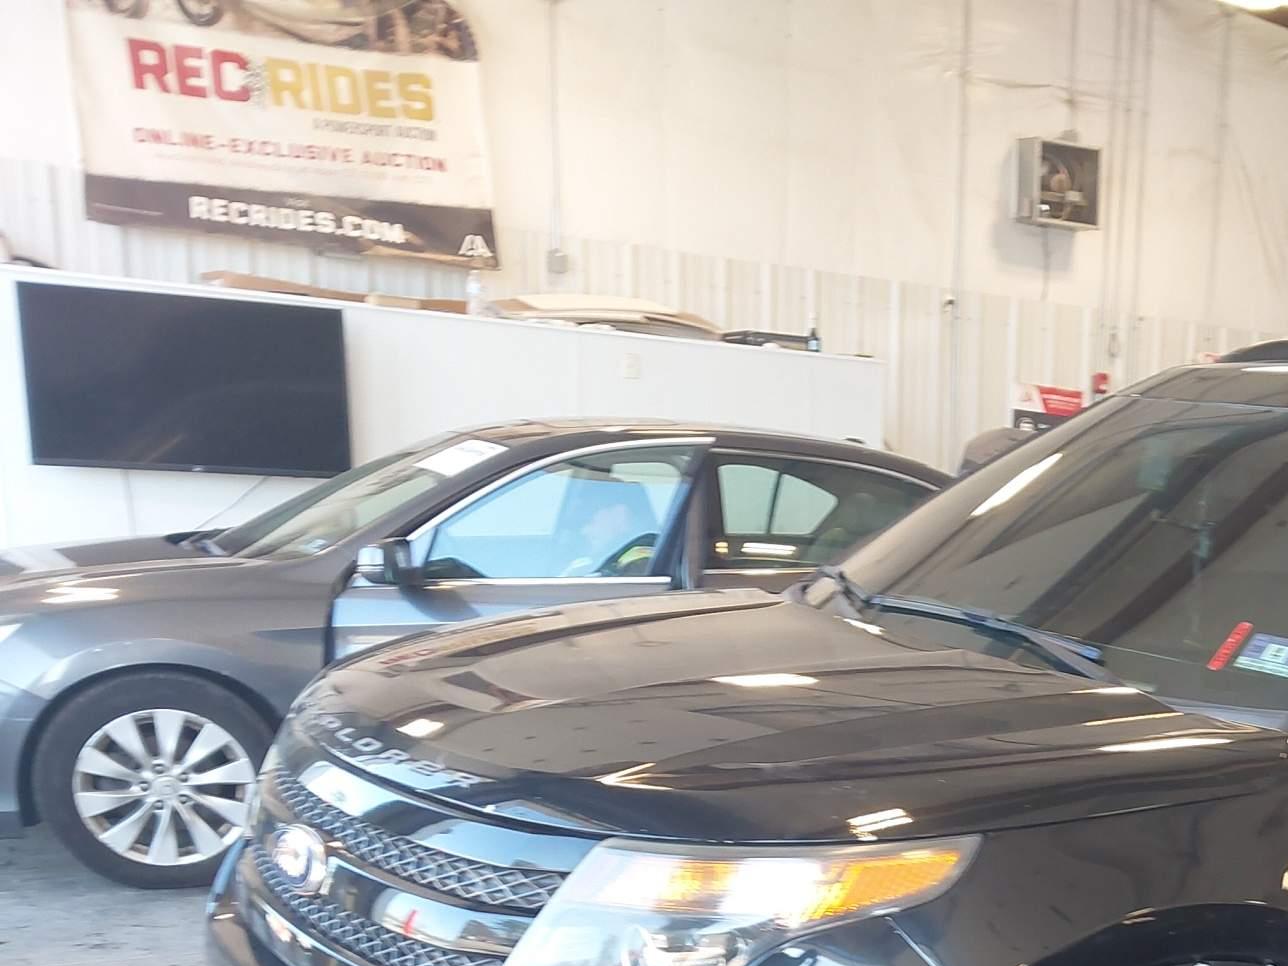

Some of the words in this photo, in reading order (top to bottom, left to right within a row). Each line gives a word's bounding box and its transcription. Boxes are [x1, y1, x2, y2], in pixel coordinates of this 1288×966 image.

[127, 38, 251, 102] REC
[264, 57, 435, 121] RIDES
[360, 150, 447, 172] AUCTION
[188, 196, 406, 244] RECRIDES.COM
